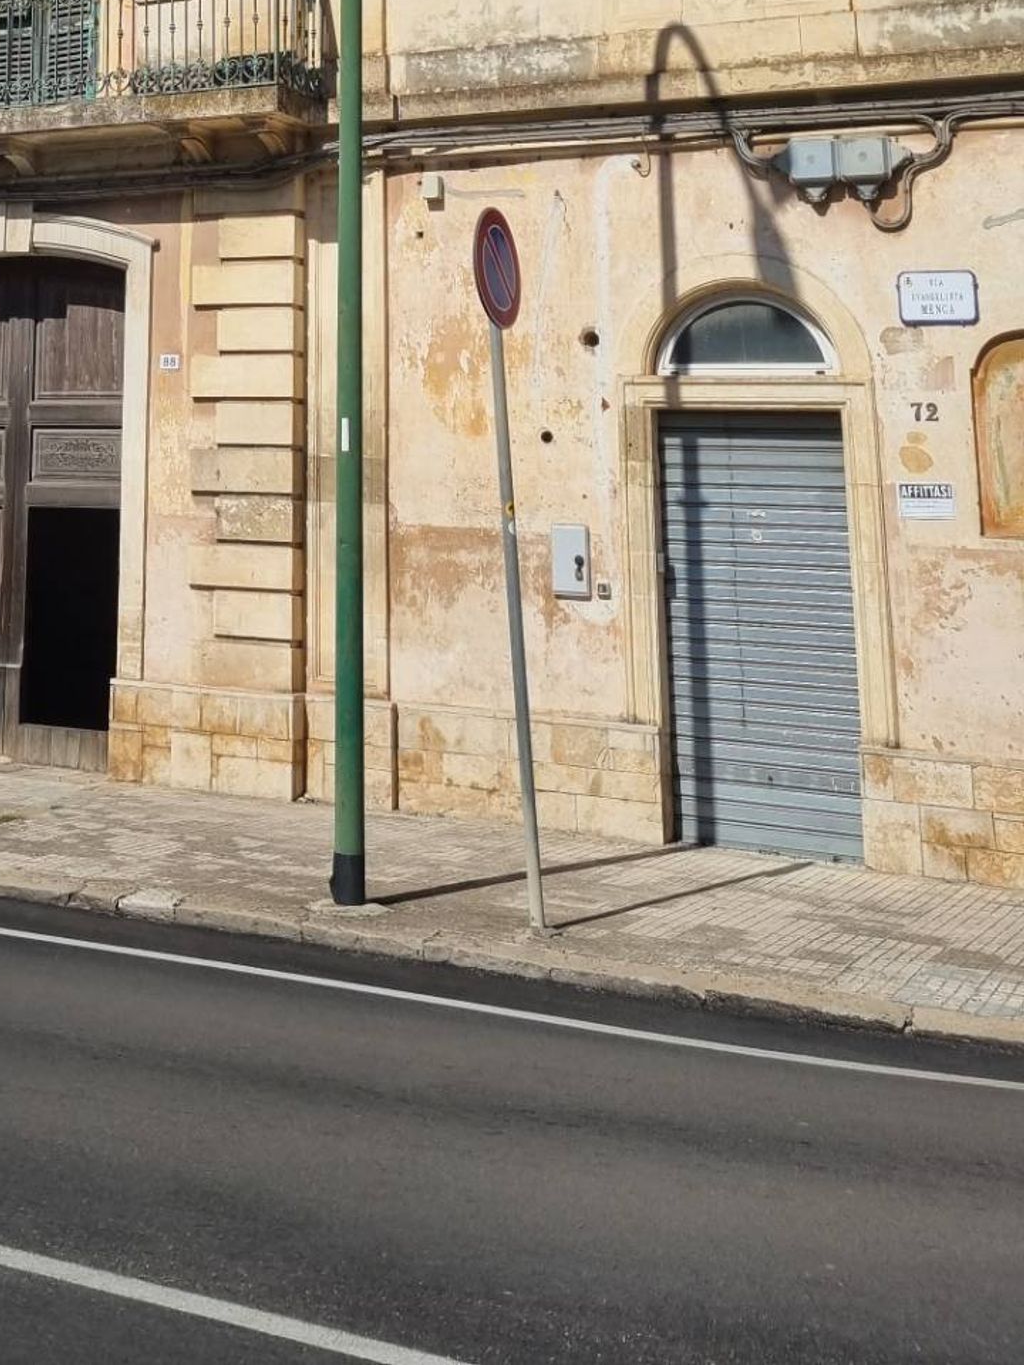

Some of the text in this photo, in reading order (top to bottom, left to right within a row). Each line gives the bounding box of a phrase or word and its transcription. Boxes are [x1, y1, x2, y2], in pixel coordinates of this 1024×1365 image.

[929, 278, 944, 287] VIA
[910, 402, 939, 422] 72
[901, 485, 952, 498] AFFITTASI
